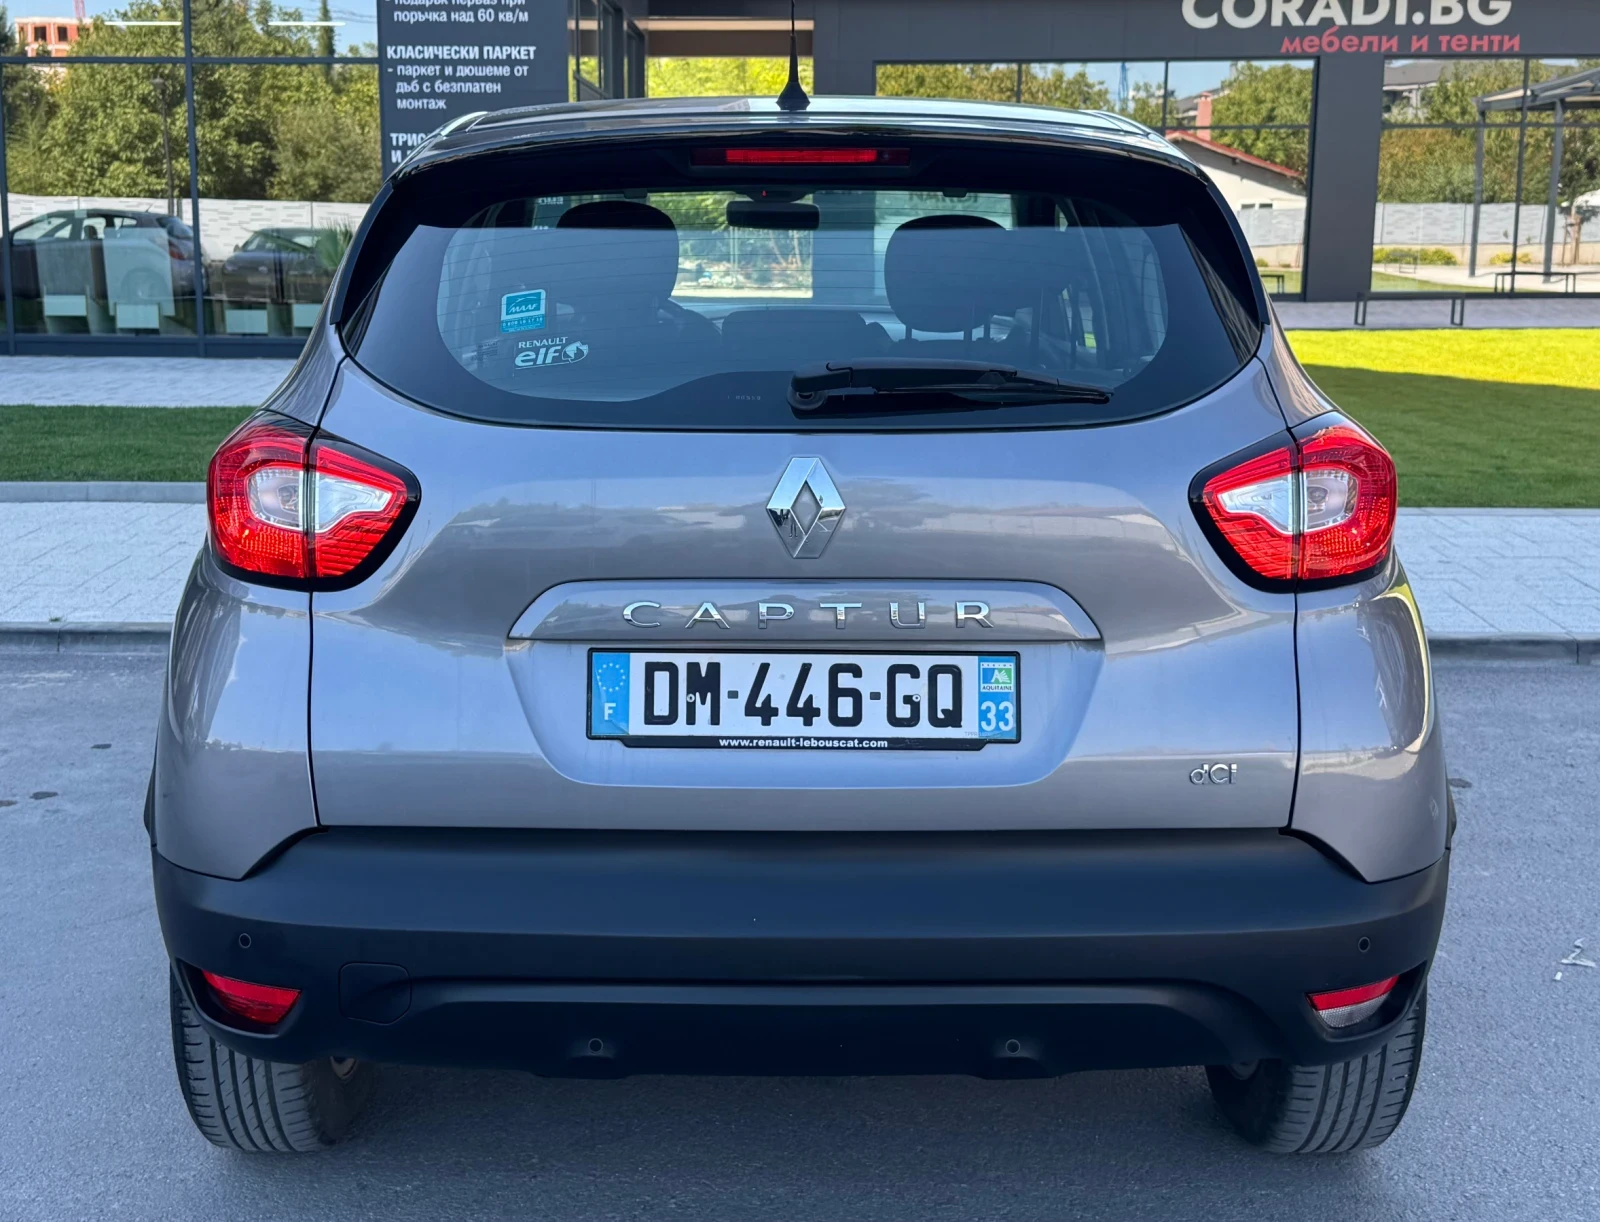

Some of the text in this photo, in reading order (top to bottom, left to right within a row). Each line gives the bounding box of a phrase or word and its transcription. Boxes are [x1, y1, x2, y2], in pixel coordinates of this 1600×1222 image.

[393, 8, 529, 24] поръчка над 60 кв/м
[1181, 0, 1512, 29] CORADI.BG
[1280, 26, 1521, 53] мебели и тенти
[386, 45, 536, 60] КЛАСИЧЕСКИ ПАРКЕТ
[397, 65, 441, 78] паркет
[444, 66, 453, 76] и
[456, 65, 511, 78] дюшеме
[513, 65, 529, 77] от
[396, 80, 501, 94] дъб с безплатен
[396, 98, 447, 110] монтаж
[518, 336, 568, 349] RENAULT
[515, 345, 562, 367] elf
[622, 601, 995, 629] CAPTUR
[644, 661, 963, 728] DM-446-GQ
[604, 702, 617, 721] F
[981, 701, 1014, 731] 33
[719, 736, 888, 748] www.renault-lebouscat.com
[1189, 763, 1238, 785] dCi
